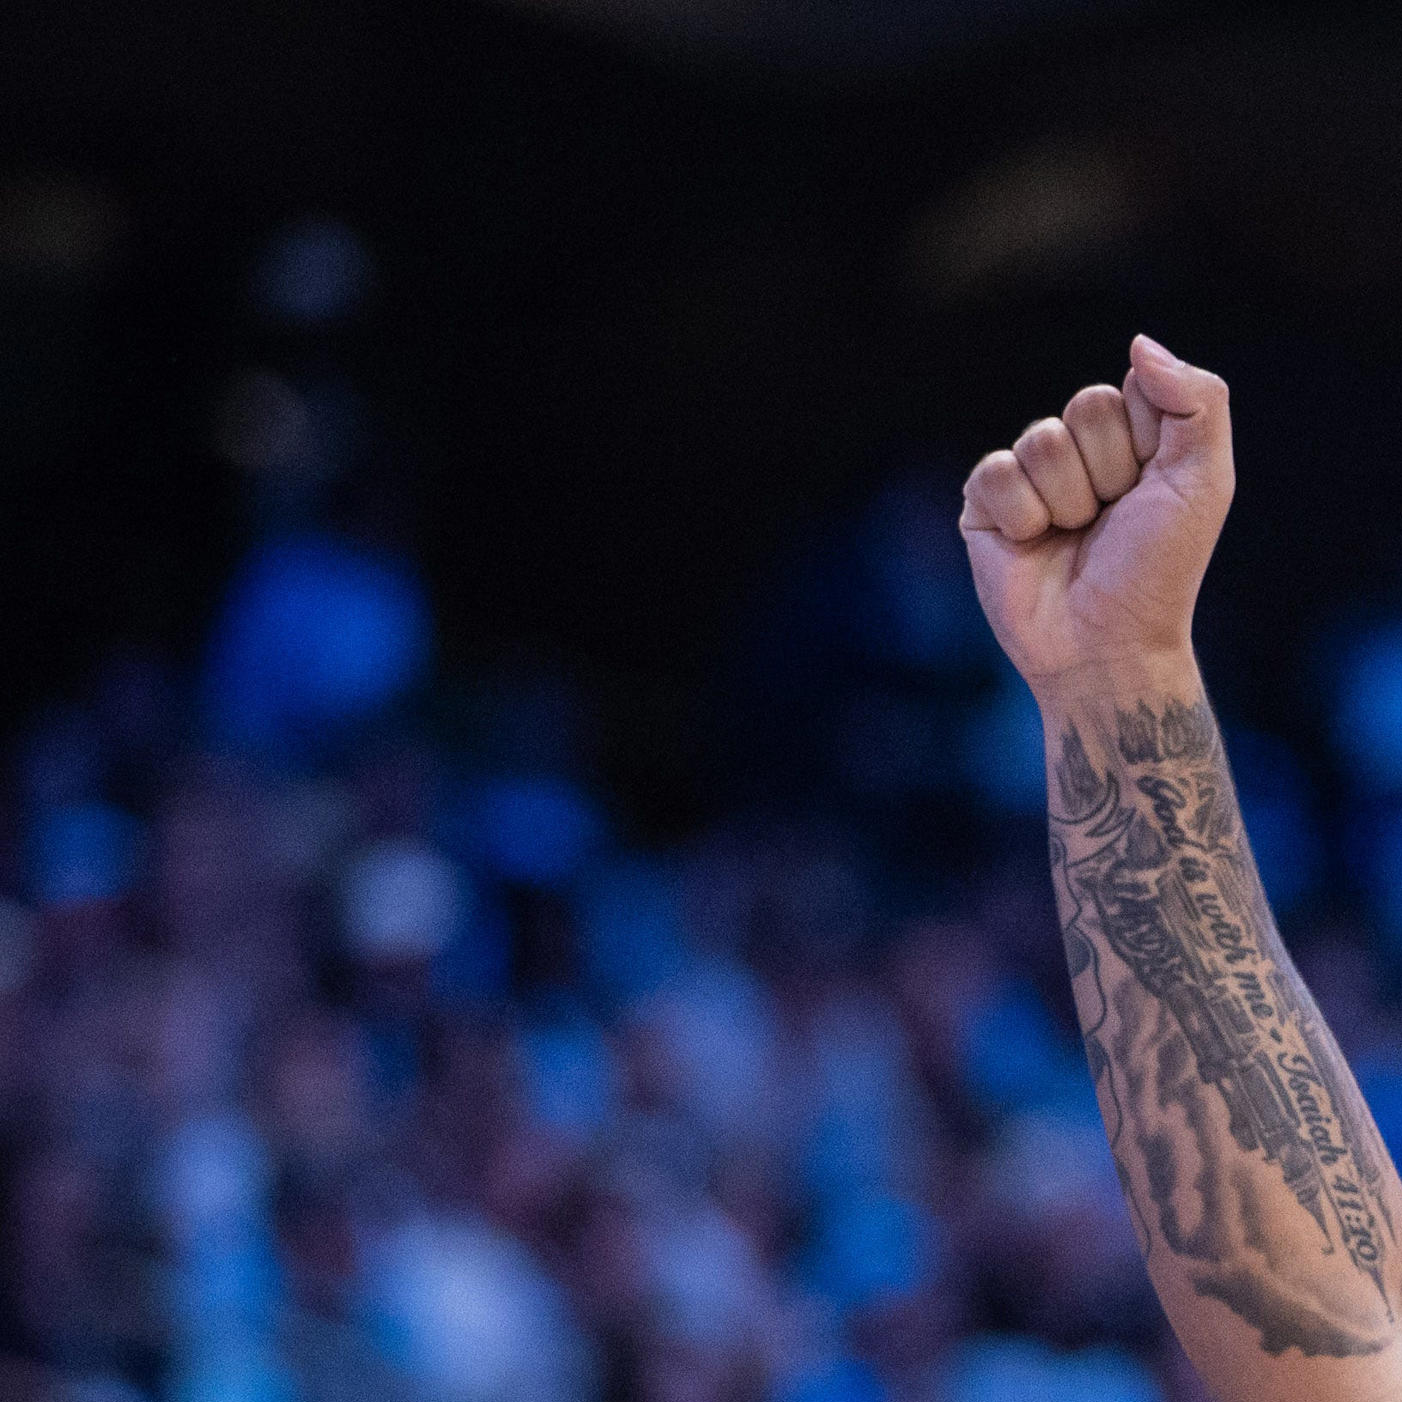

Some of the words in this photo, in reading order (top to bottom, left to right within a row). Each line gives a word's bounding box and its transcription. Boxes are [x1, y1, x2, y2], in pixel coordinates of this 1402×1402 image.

[1136, 775, 1209, 852] God
[1179, 856, 1210, 882] is
[1195, 893, 1256, 964] with
[1231, 971, 1273, 1018] me
[1277, 1051, 1348, 1166] Isaiah
